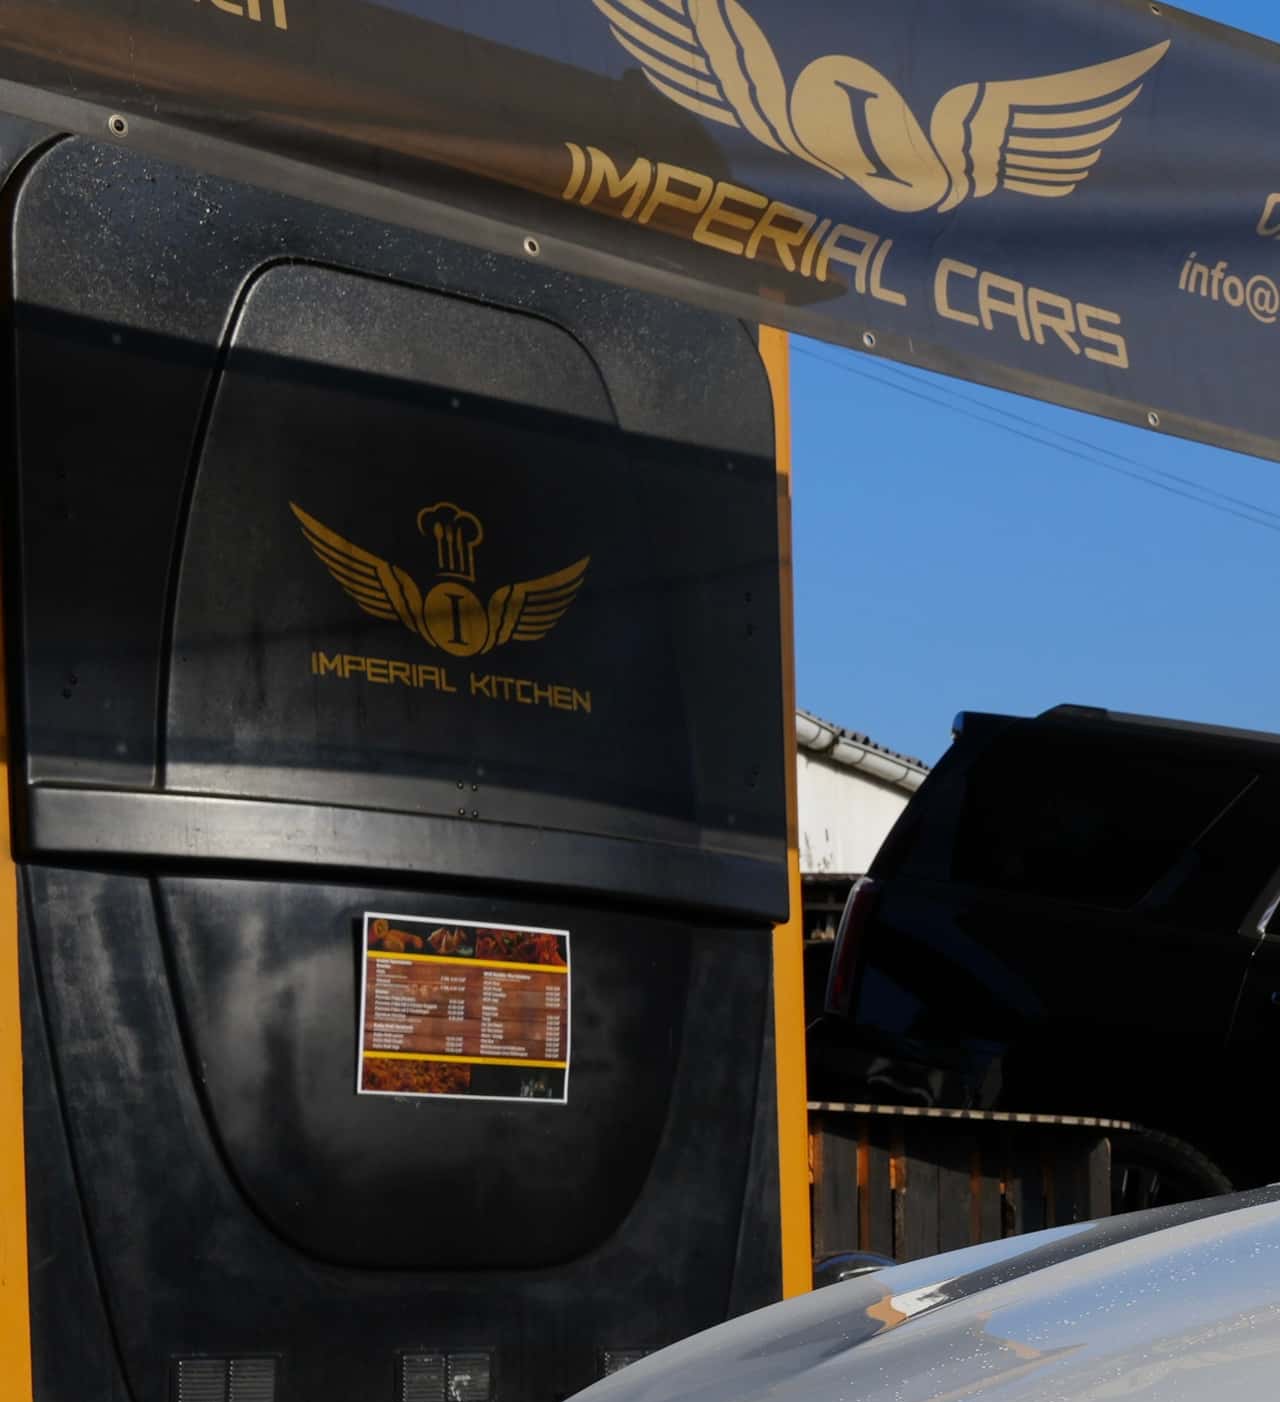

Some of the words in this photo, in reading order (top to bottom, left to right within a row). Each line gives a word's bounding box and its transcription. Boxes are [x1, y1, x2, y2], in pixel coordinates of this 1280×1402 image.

[561, 141, 908, 307] IMPERIAL
[933, 256, 1129, 369] CARS
[310, 650, 457, 693] IMPERIAL
[469, 671, 592, 713] KITCHEN
